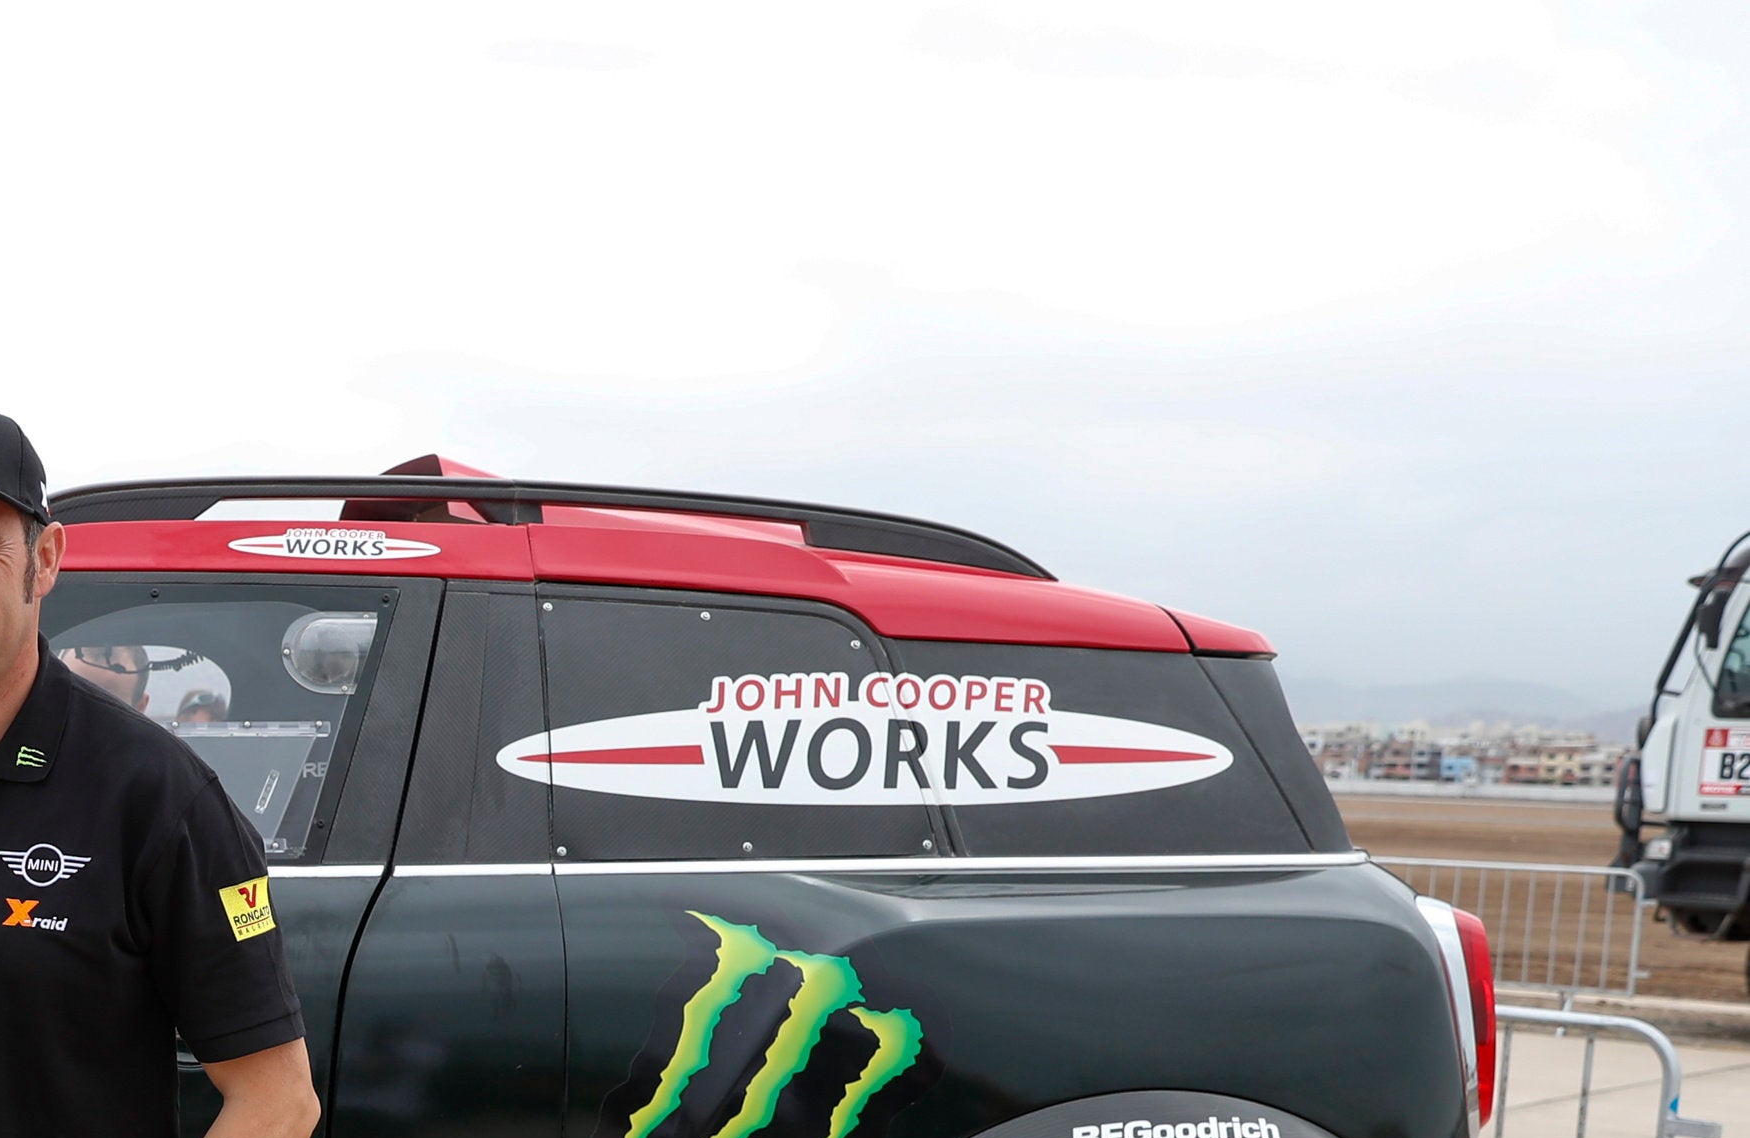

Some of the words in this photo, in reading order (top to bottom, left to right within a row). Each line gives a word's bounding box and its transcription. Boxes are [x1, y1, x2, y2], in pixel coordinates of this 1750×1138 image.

[285, 529, 325, 538] JOHN
[329, 530, 384, 540] COOPER
[285, 538, 385, 556] WORKS
[705, 676, 843, 713] JOHN
[865, 677, 1048, 714] COOPER
[709, 719, 1051, 792] WORKS
[27, 858, 59, 871] MINI
